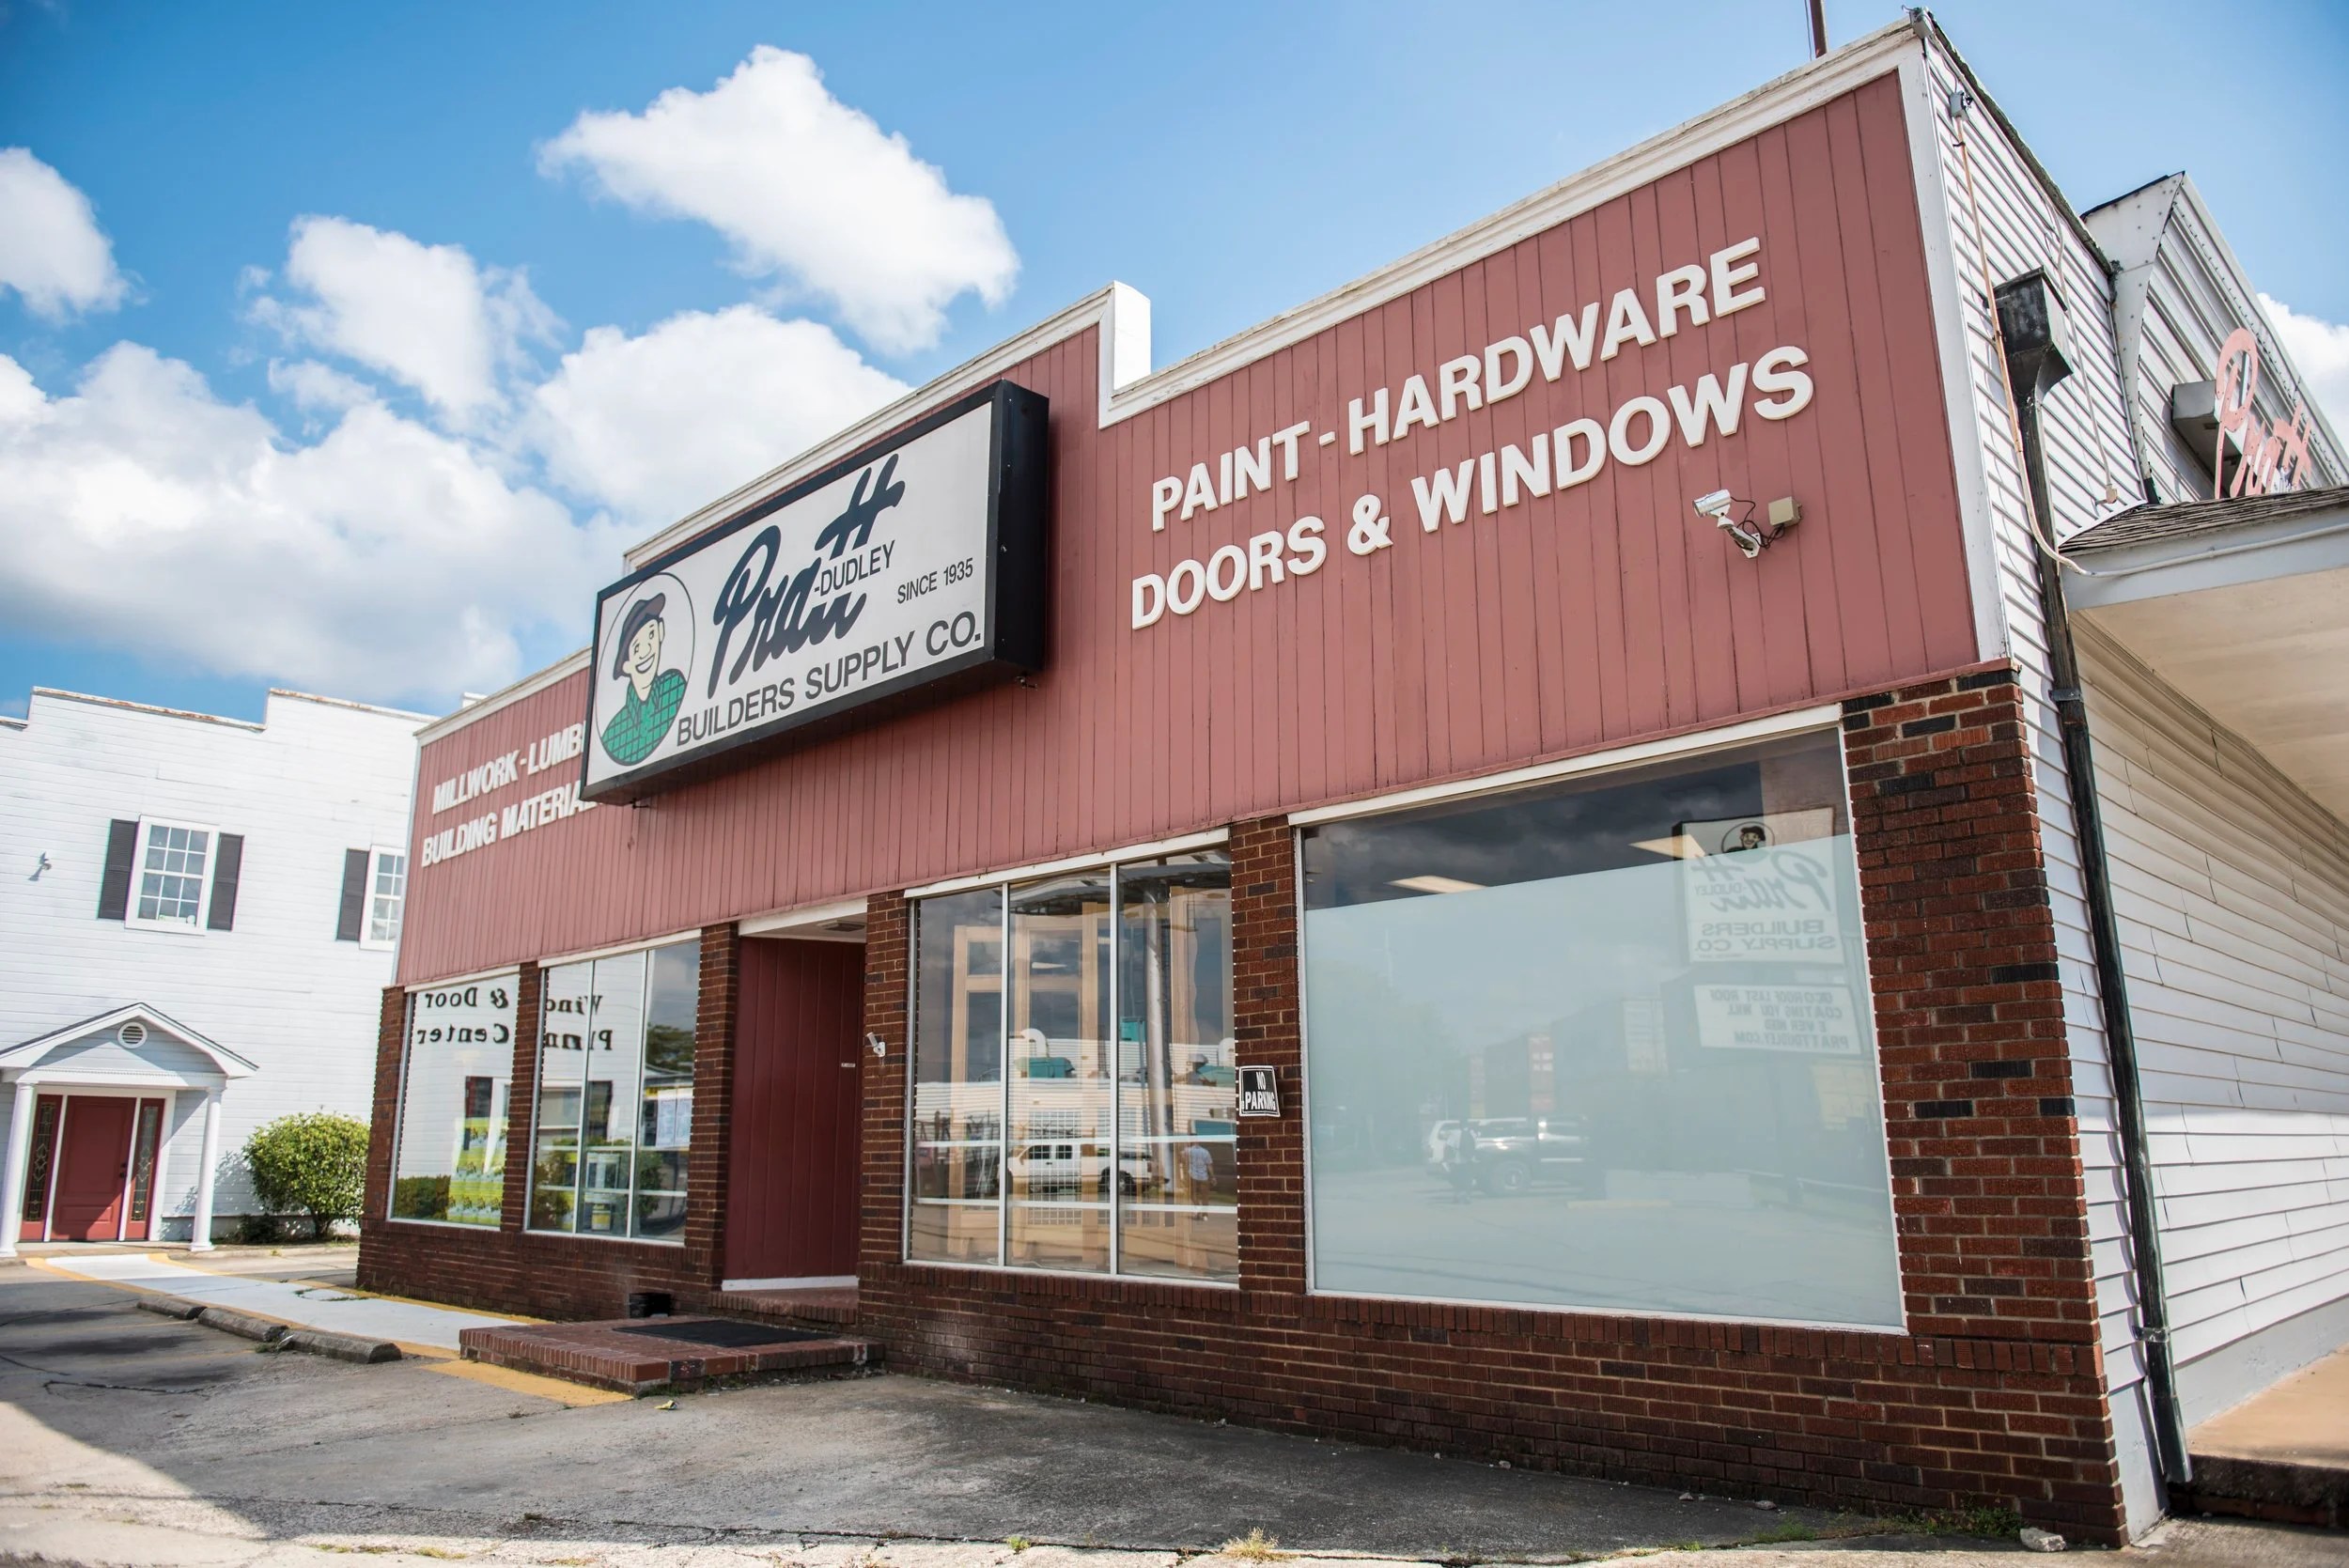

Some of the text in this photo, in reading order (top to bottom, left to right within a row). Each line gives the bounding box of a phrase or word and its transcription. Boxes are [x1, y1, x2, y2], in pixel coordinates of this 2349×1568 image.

[1152, 420, 1312, 533] PAINT
[1347, 236, 1766, 456] HARDWARE
[1131, 345, 1813, 629] DOORS & WINDOWS
[896, 557, 973, 604] SINCE 1935
[677, 611, 981, 747] BUILDERS SUPPLY CO.
[432, 750, 520, 815] MILLWORK
[527, 720, 586, 775] LUMB
[421, 780, 602, 867] BUILDING MATERIA
[1245, 1091, 1276, 1110] PARKING
[1256, 1071, 1266, 1090] NO
